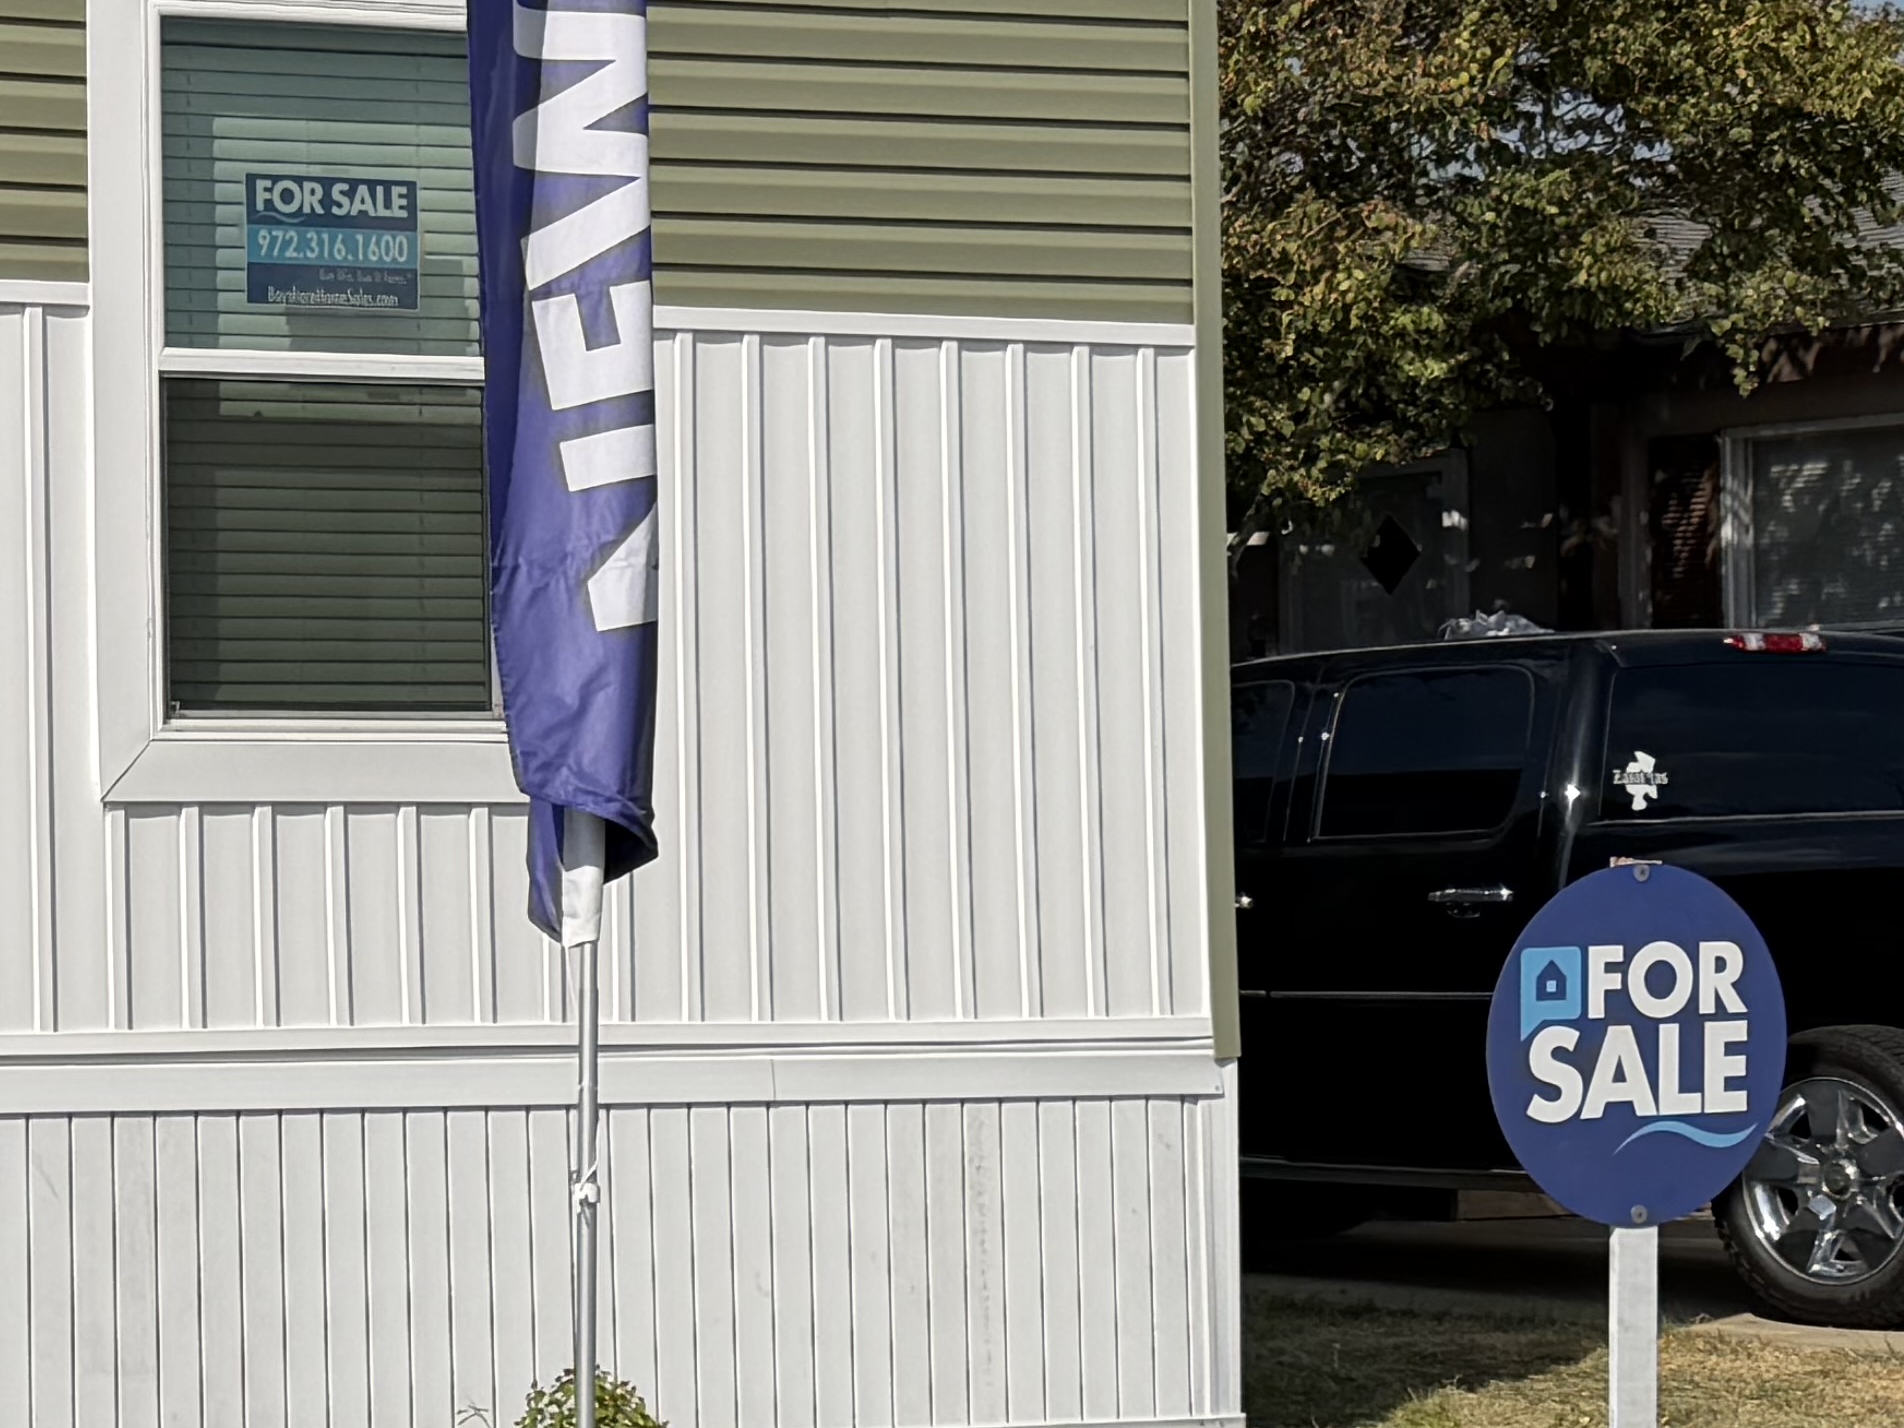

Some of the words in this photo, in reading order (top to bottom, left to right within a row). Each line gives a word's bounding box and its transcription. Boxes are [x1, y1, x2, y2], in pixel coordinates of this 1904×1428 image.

[255, 179, 324, 214] FOR
[331, 183, 408, 217] SALE
[258, 228, 408, 262] 972.316.1600
[1587, 940, 1748, 1019] FOR
[1525, 1020, 1748, 1123] SALE
